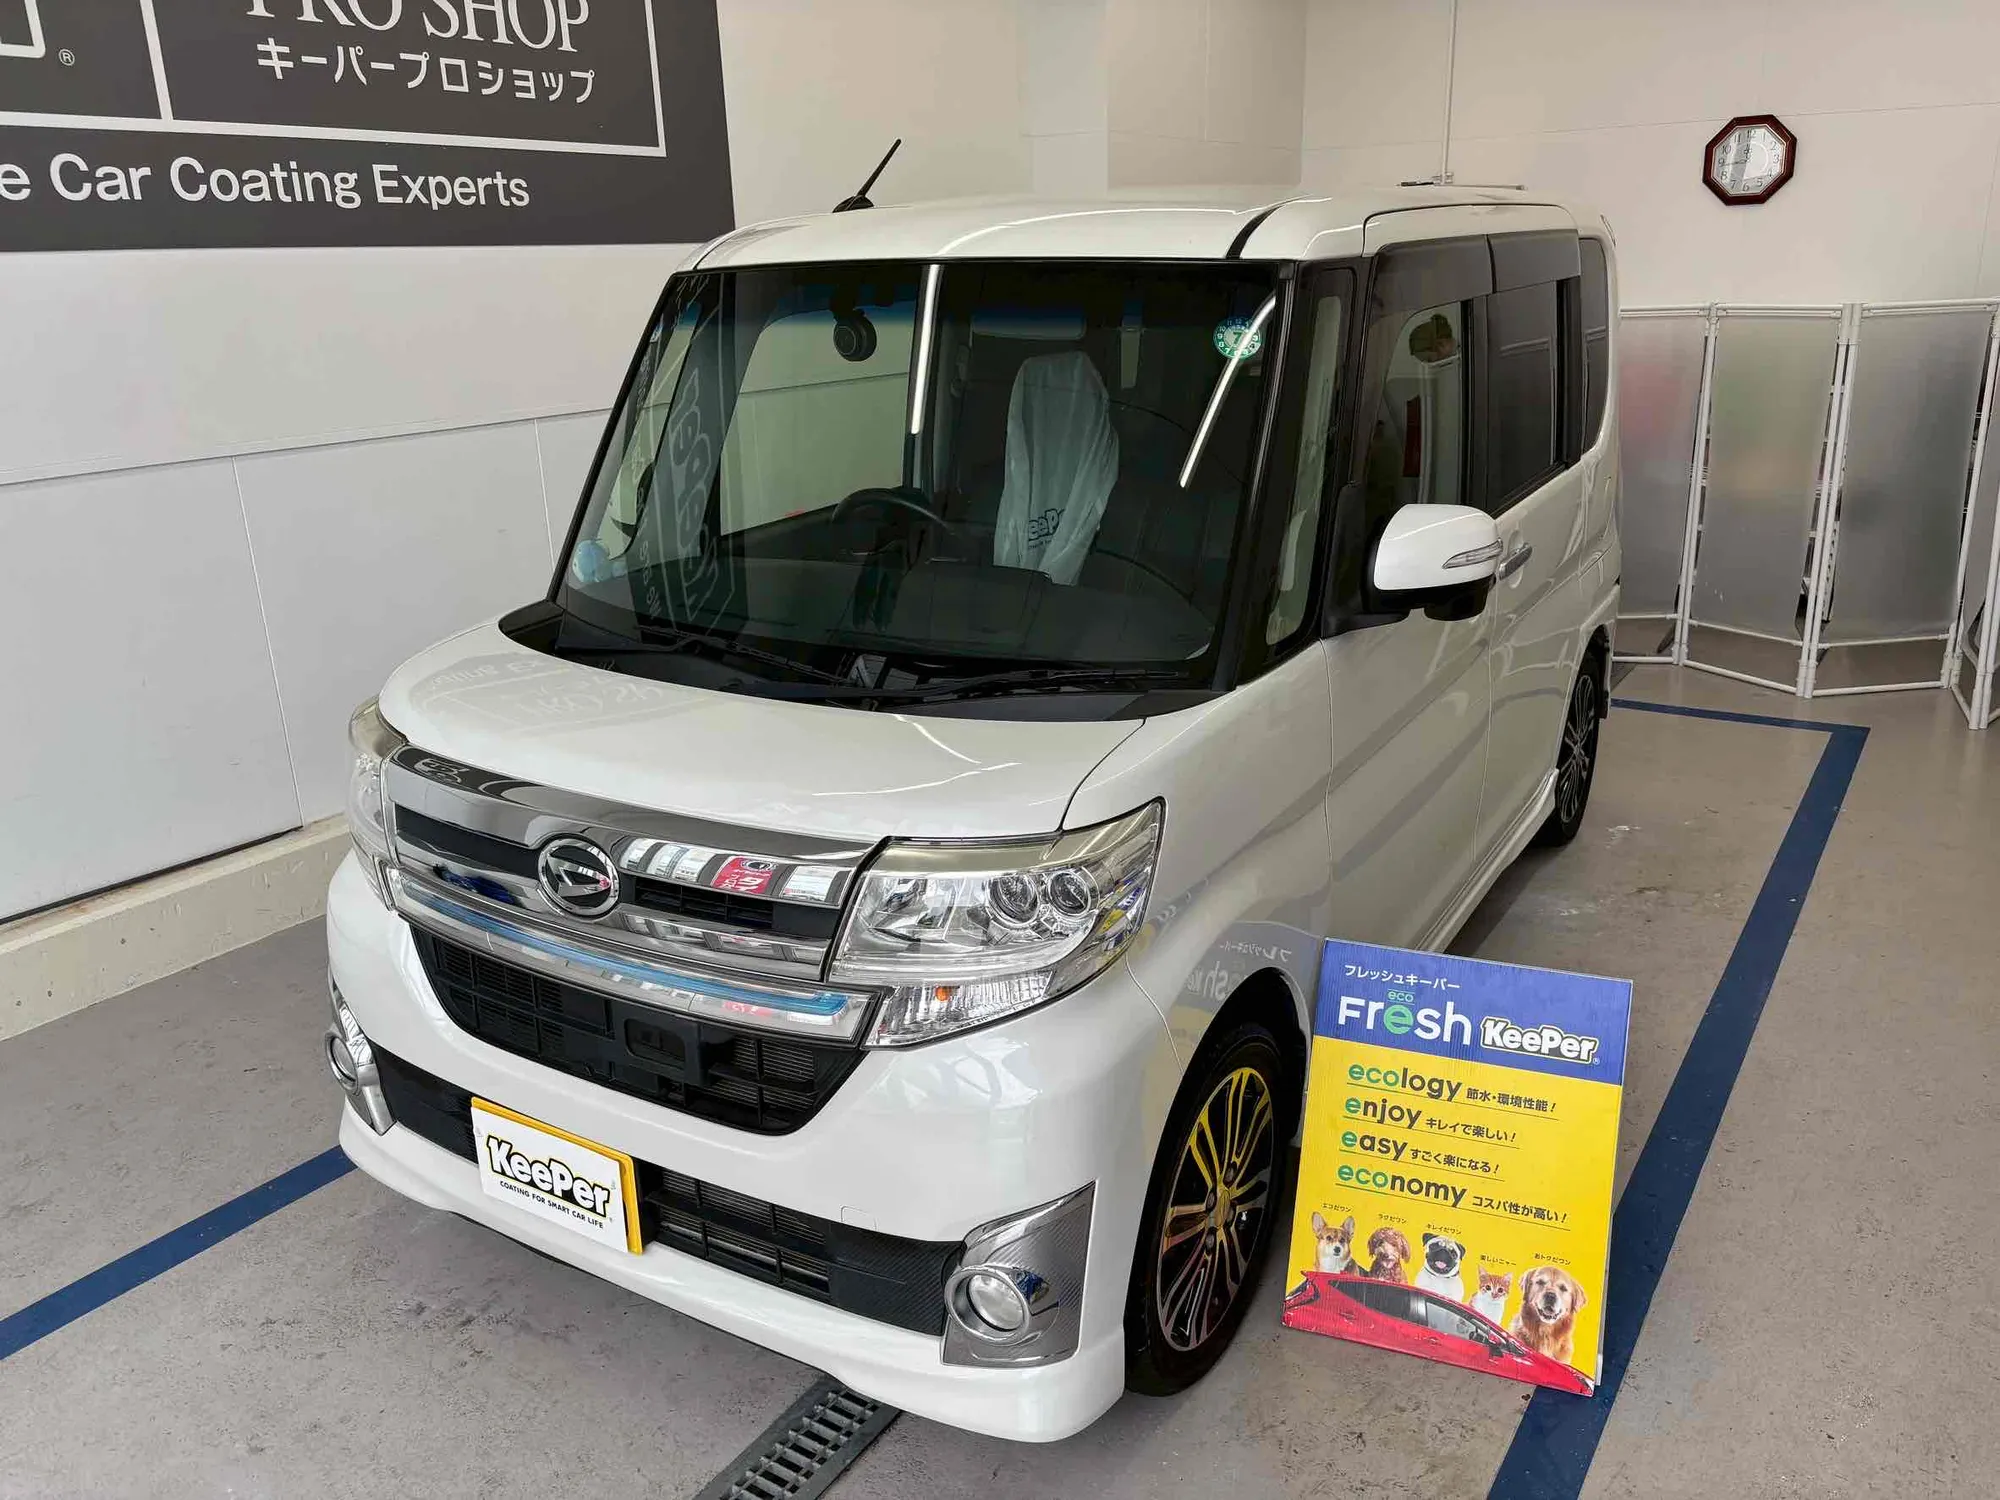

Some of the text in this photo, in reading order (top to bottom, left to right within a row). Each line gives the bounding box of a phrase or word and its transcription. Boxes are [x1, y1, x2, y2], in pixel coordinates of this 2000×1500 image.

[257, 37, 596, 103] キーパープロショップ
[50, 152, 152, 201] Car
[169, 156, 362, 209] Coating
[371, 163, 529, 211] Experts
[1387, 989, 1414, 1003] eco
[1338, 995, 1599, 1064] Fresh KeePer
[1348, 1064, 1462, 1102] ecology
[1345, 1097, 1422, 1129] enjoy
[1341, 1130, 1408, 1161] easy
[486, 1134, 610, 1218] KeePer
[1337, 1164, 1467, 1208] economy
[500, 1182, 603, 1229] COATING FOR SMART CAR LIFE
